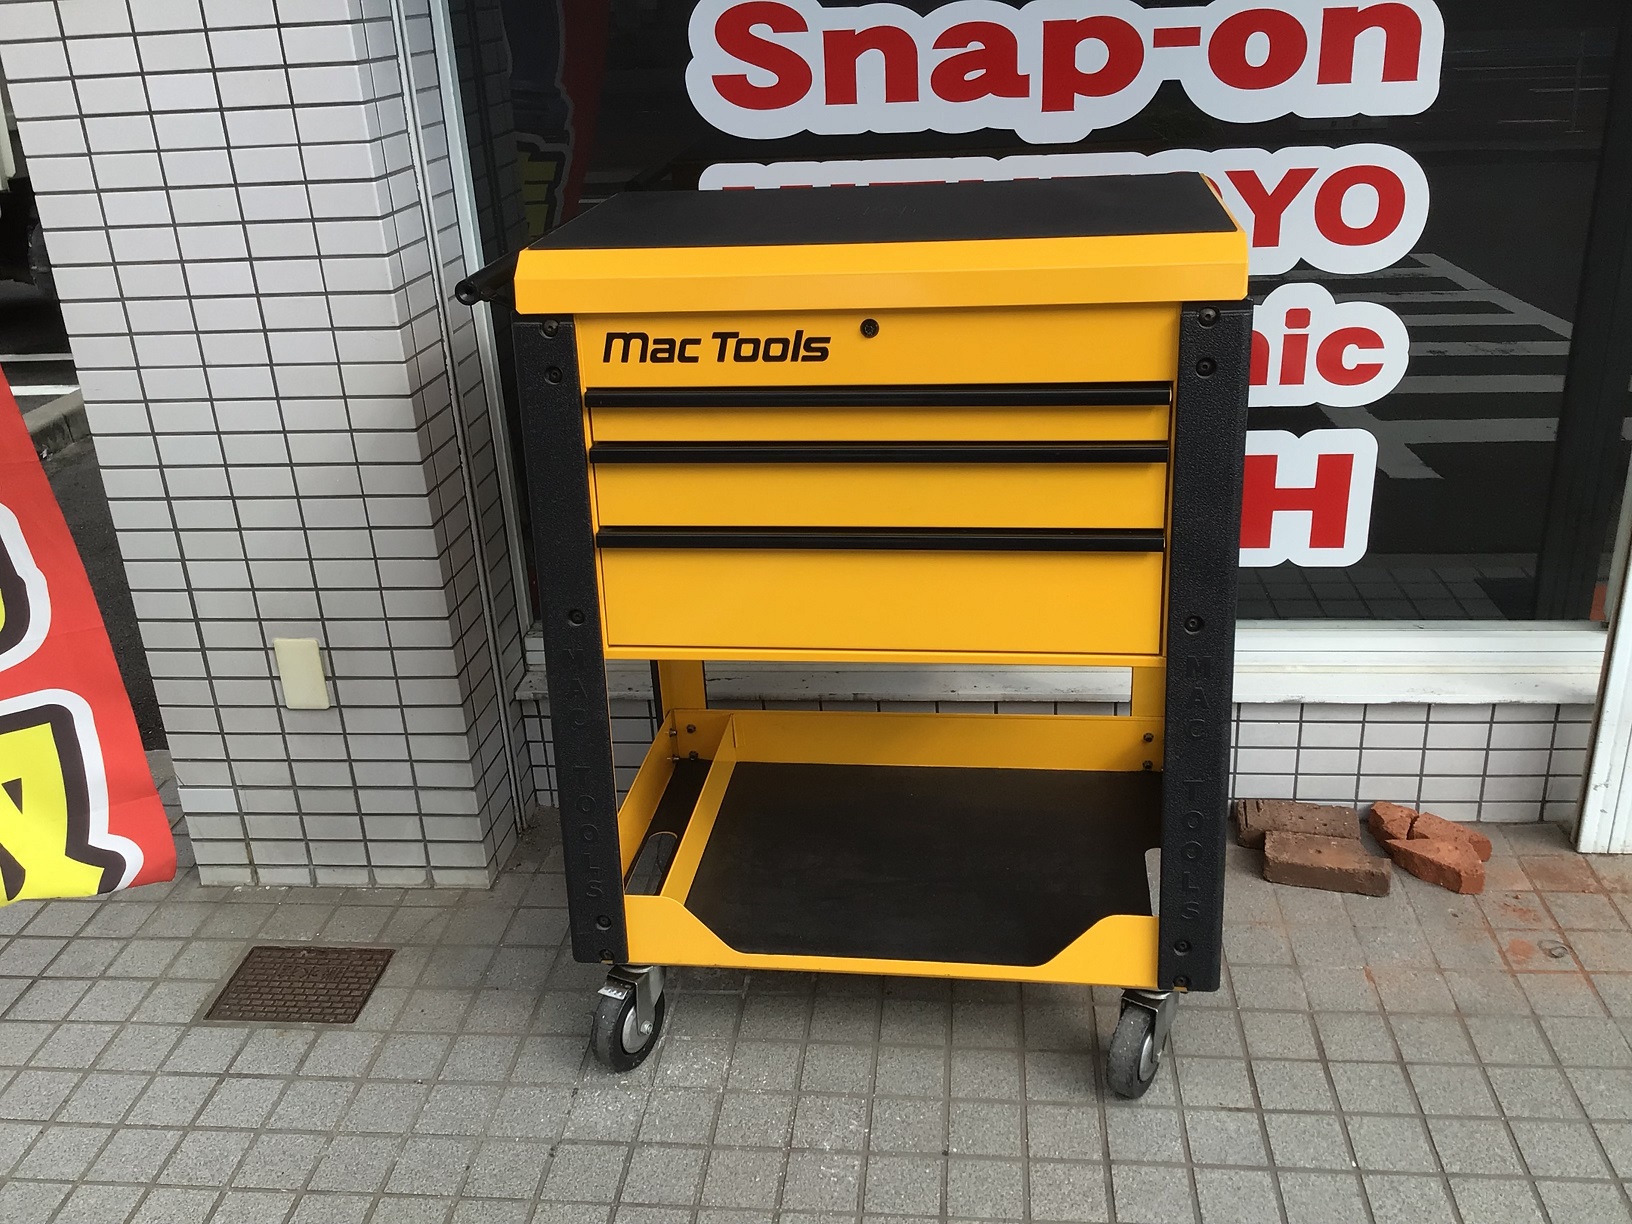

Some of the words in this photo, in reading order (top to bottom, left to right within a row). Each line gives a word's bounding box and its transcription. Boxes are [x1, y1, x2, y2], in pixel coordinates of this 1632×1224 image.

[711, 0, 1422, 113] Snap-on
[711, 329, 831, 363] Tools
[1185, 654, 1212, 741] MAC
[572, 767, 604, 901] TOOLS
[1180, 779, 1206, 921] TOOLS
